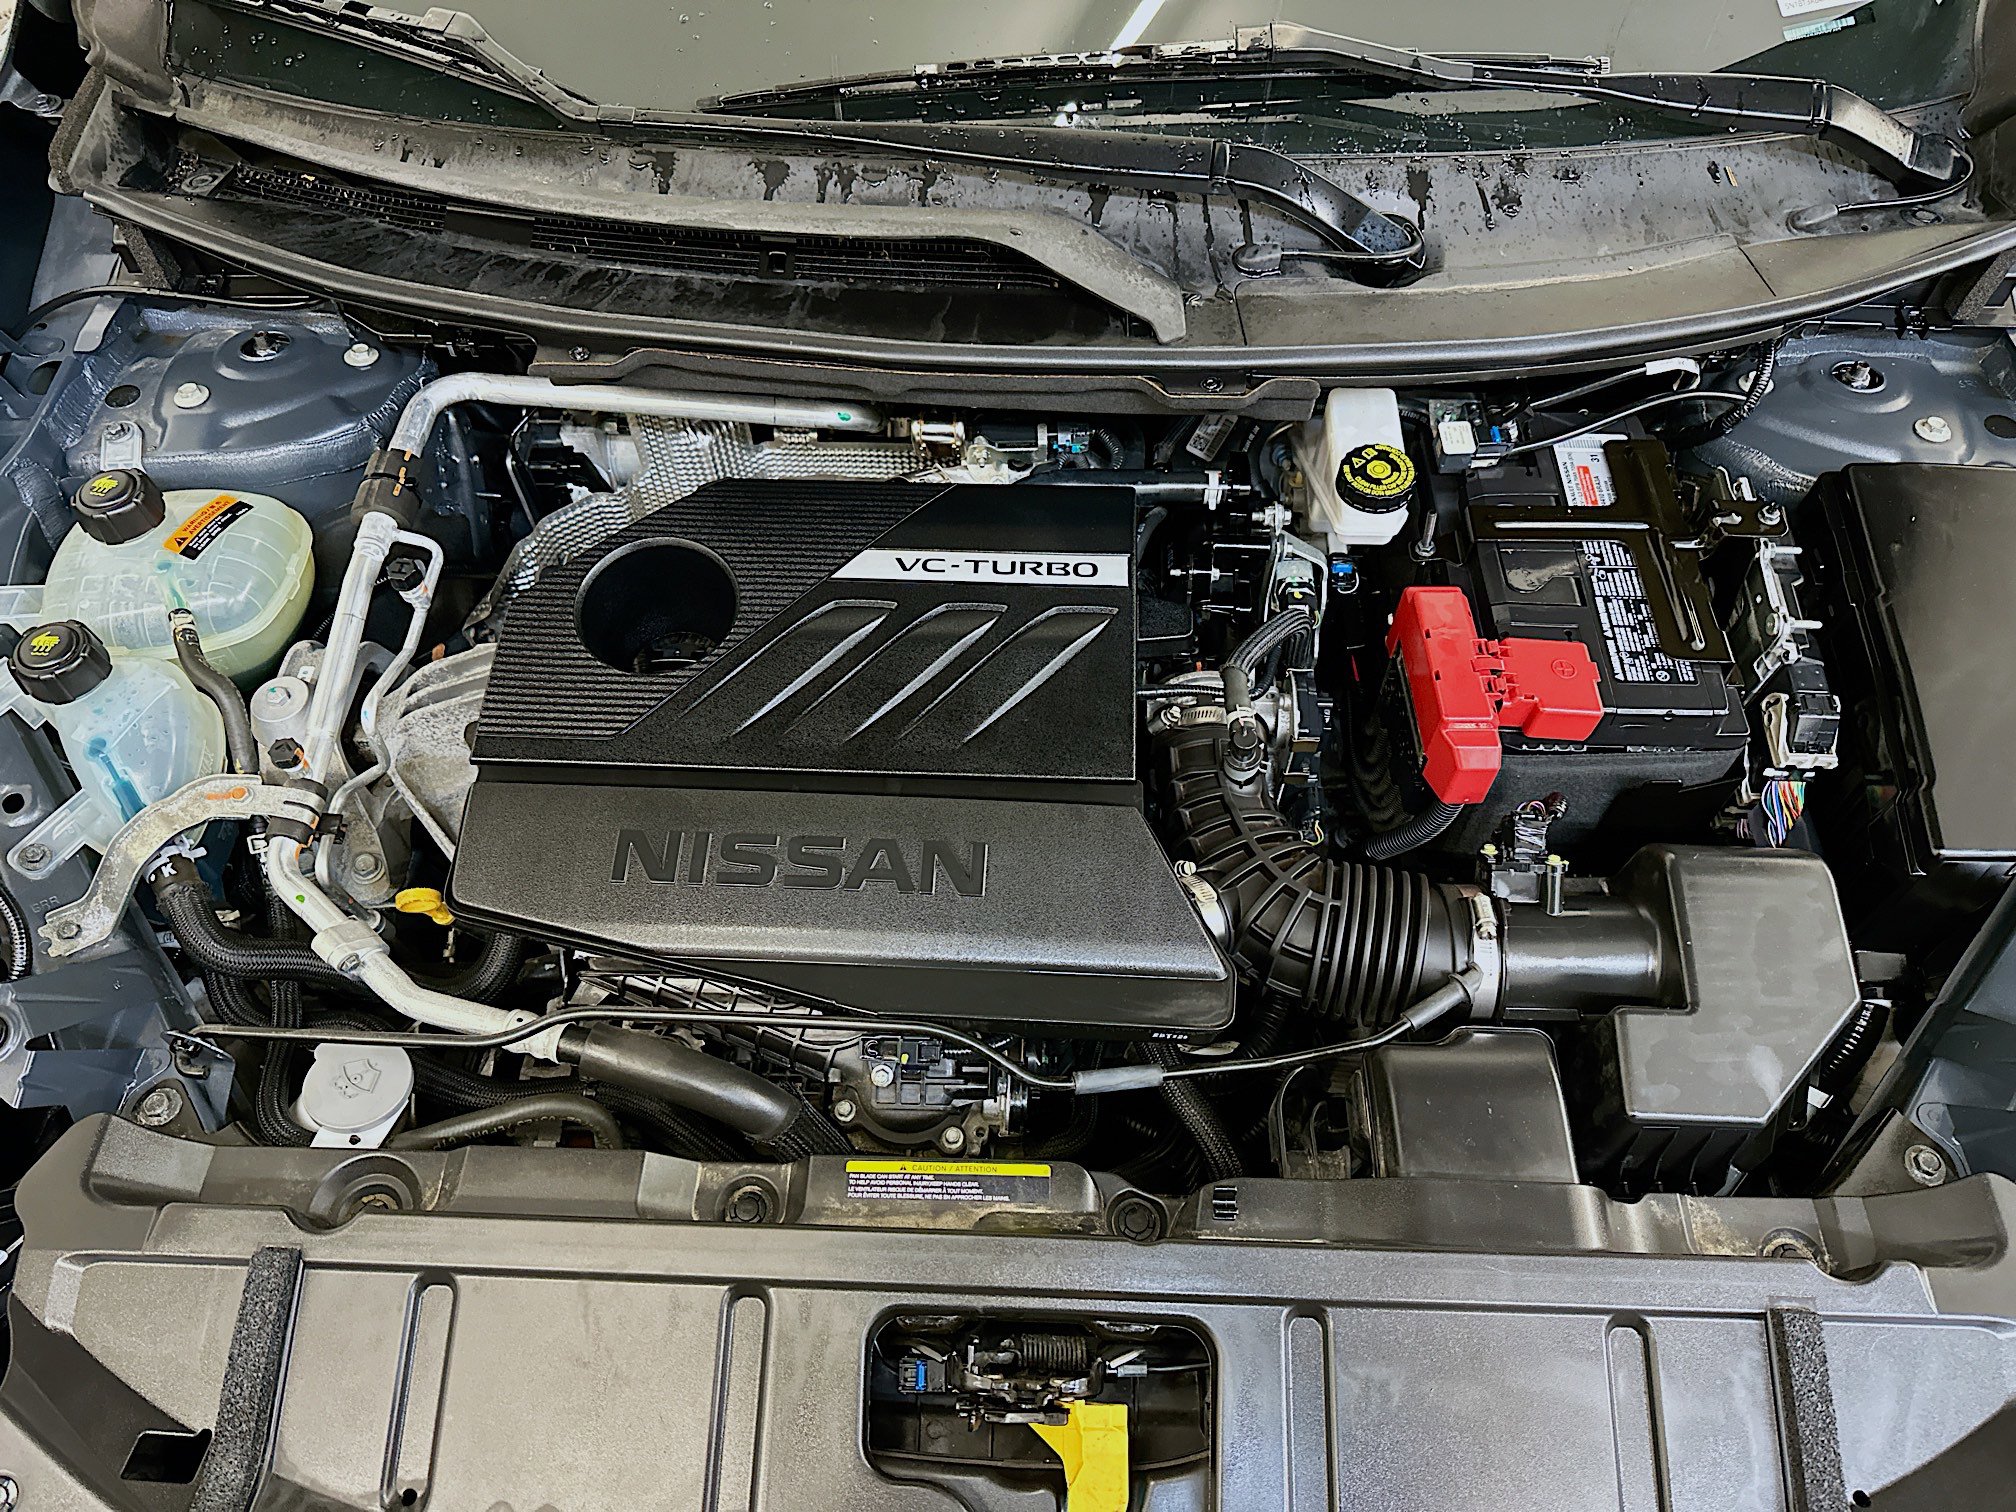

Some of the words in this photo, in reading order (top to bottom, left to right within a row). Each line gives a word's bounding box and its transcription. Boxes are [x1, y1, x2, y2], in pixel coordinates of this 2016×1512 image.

[895, 557, 1099, 578] VC-TURBO
[610, 829, 988, 898] NISSAN
[912, 1164, 947, 1172] CAUTION
[955, 1165, 998, 1173] ATTENTION
